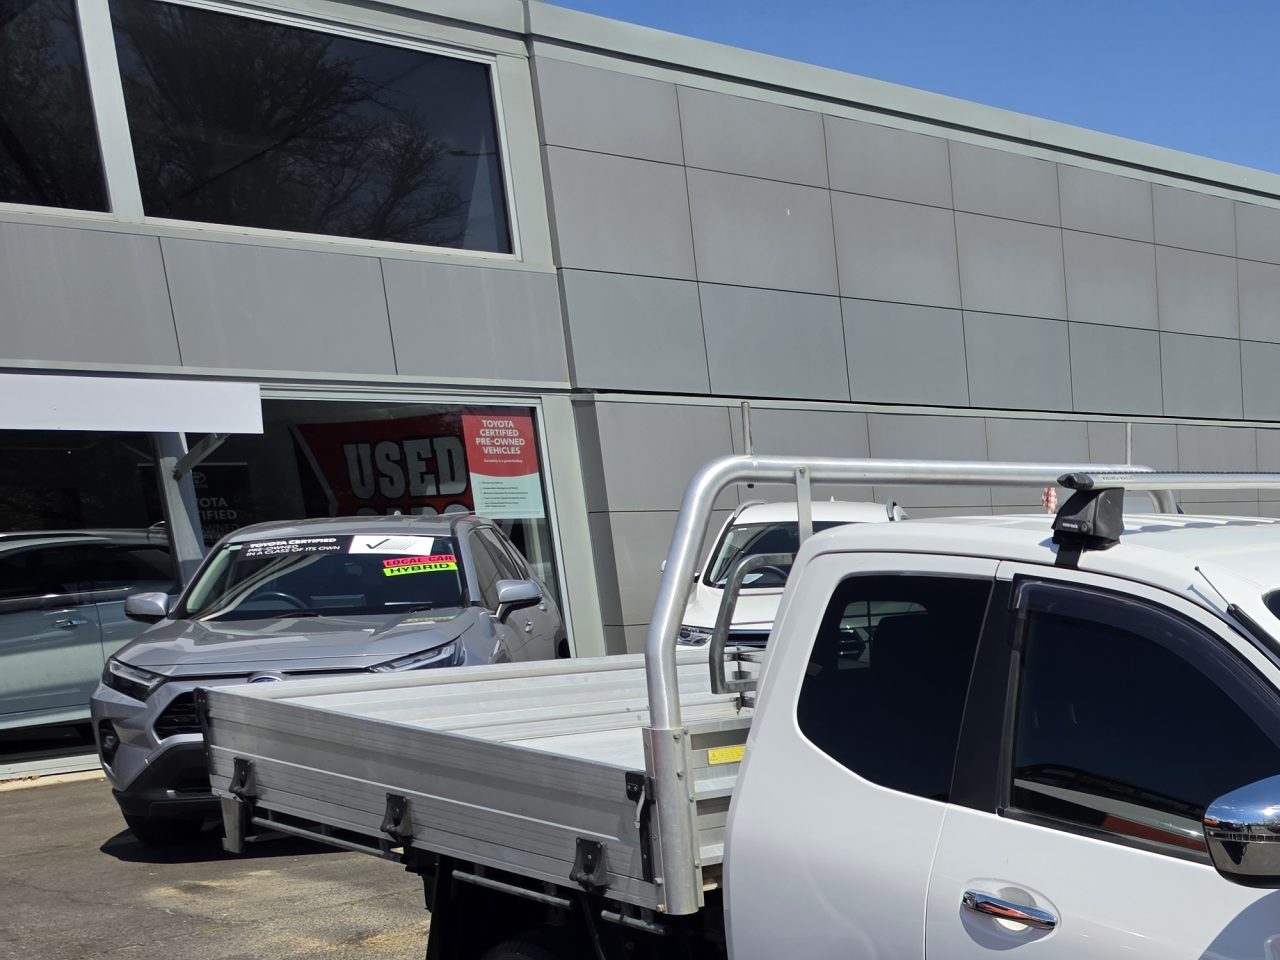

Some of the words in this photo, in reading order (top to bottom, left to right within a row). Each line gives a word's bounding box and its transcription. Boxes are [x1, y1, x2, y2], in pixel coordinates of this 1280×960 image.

[481, 420, 515, 428] TOYOTA
[479, 428, 519, 437] CERTIFIED
[475, 437, 526, 446] PRE-OWNED
[482, 446, 521, 455] VEHICLES
[343, 436, 467, 500] USED
[249, 540, 287, 549] TOYOTA
[288, 537, 337, 545] CERTIFIED
[386, 556, 422, 566] LOCAL
[428, 555, 453, 563] CAR
[390, 563, 450, 574] HYBRID
